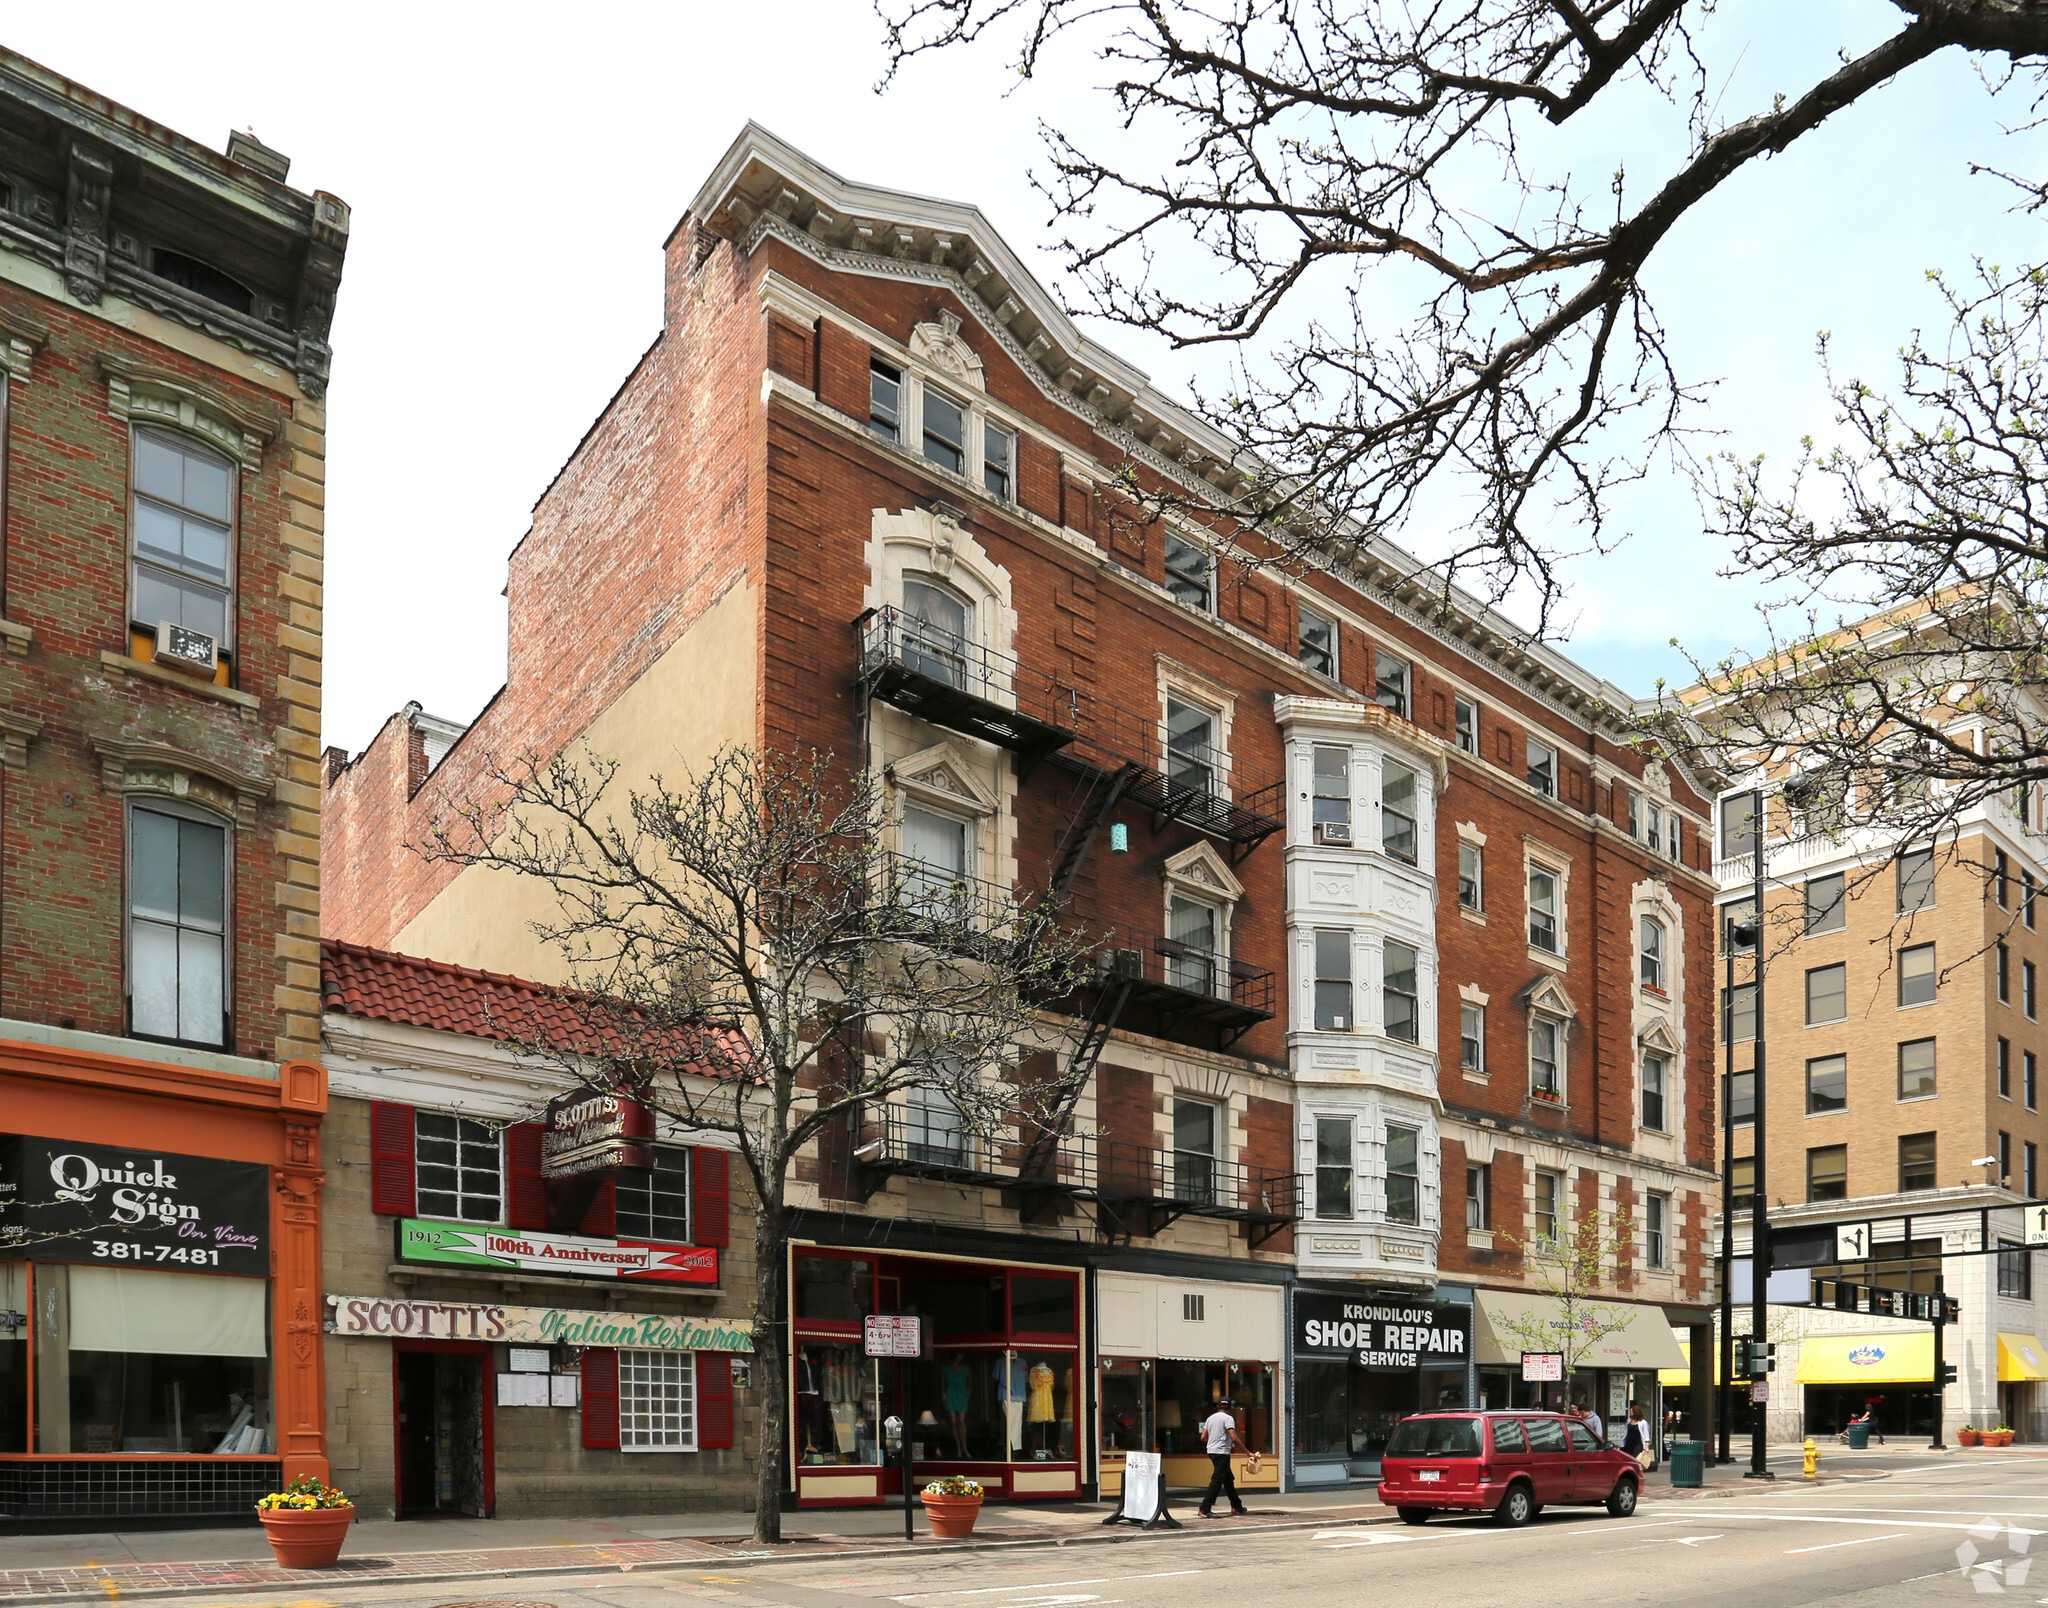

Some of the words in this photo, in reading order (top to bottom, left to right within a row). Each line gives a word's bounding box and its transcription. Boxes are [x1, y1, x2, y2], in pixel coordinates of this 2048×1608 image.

[50, 1154, 178, 1202] Quick
[109, 1188, 201, 1225] Sign
[178, 1221, 207, 1239] On
[214, 1225, 259, 1243] Vine
[407, 1230, 442, 1245] 1912
[92, 1240, 219, 1266] 381-7481
[487, 1236, 534, 1257] 100th
[540, 1243, 648, 1267] Anniversary
[683, 1255, 714, 1268] 2012
[347, 1300, 505, 1339] SCOTTI'S
[539, 1311, 637, 1344] Italian
[637, 1314, 755, 1351] Restauran
[1343, 1304, 1433, 1324] KRONDILOU'S
[1305, 1319, 1372, 1348] SHOE
[1384, 1325, 1464, 1353] REPAIR
[1359, 1350, 1417, 1367] SERVICE
